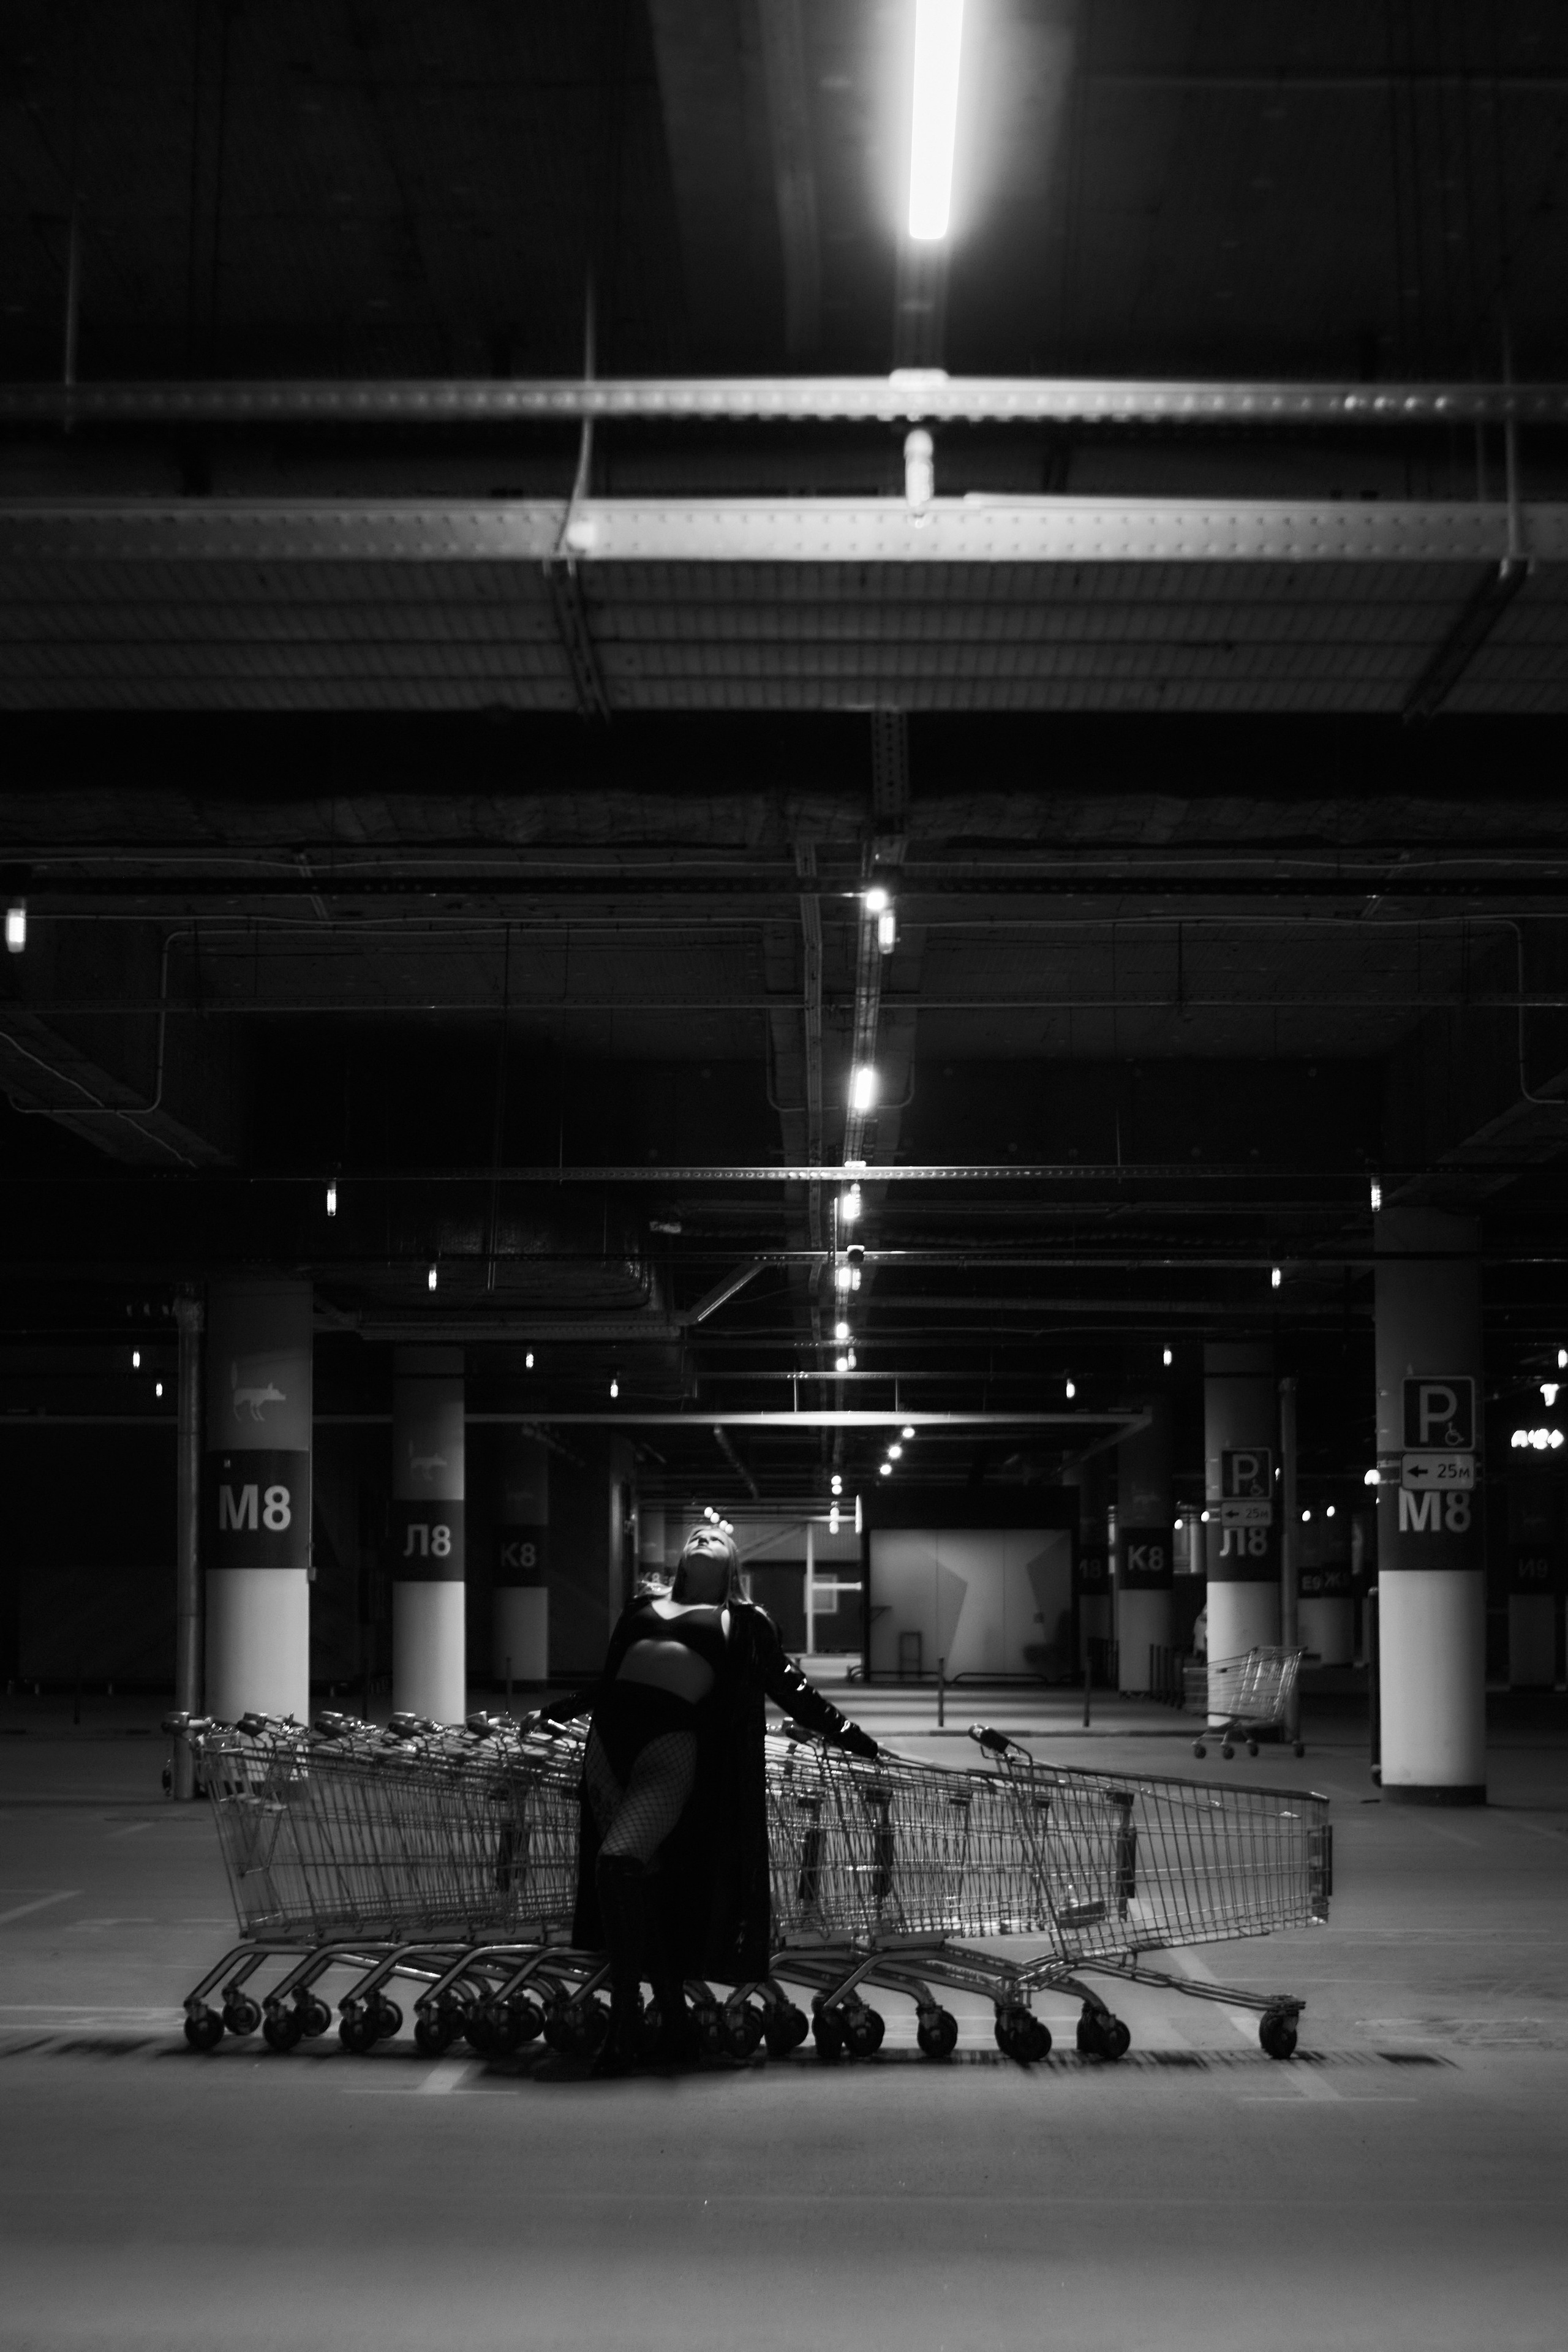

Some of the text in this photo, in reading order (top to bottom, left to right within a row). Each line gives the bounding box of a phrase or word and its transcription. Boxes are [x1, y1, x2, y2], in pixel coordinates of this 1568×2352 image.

[1419, 1385, 1457, 1442] P
[1232, 1454, 1259, 1494] P
[219, 1484, 291, 1531] М8
[1398, 1487, 1471, 1532] М8
[403, 1523, 451, 1556] Л8
[500, 1542, 536, 1567] К8
[1128, 1544, 1164, 1571] К8
[1219, 1527, 1268, 1556] Л8
